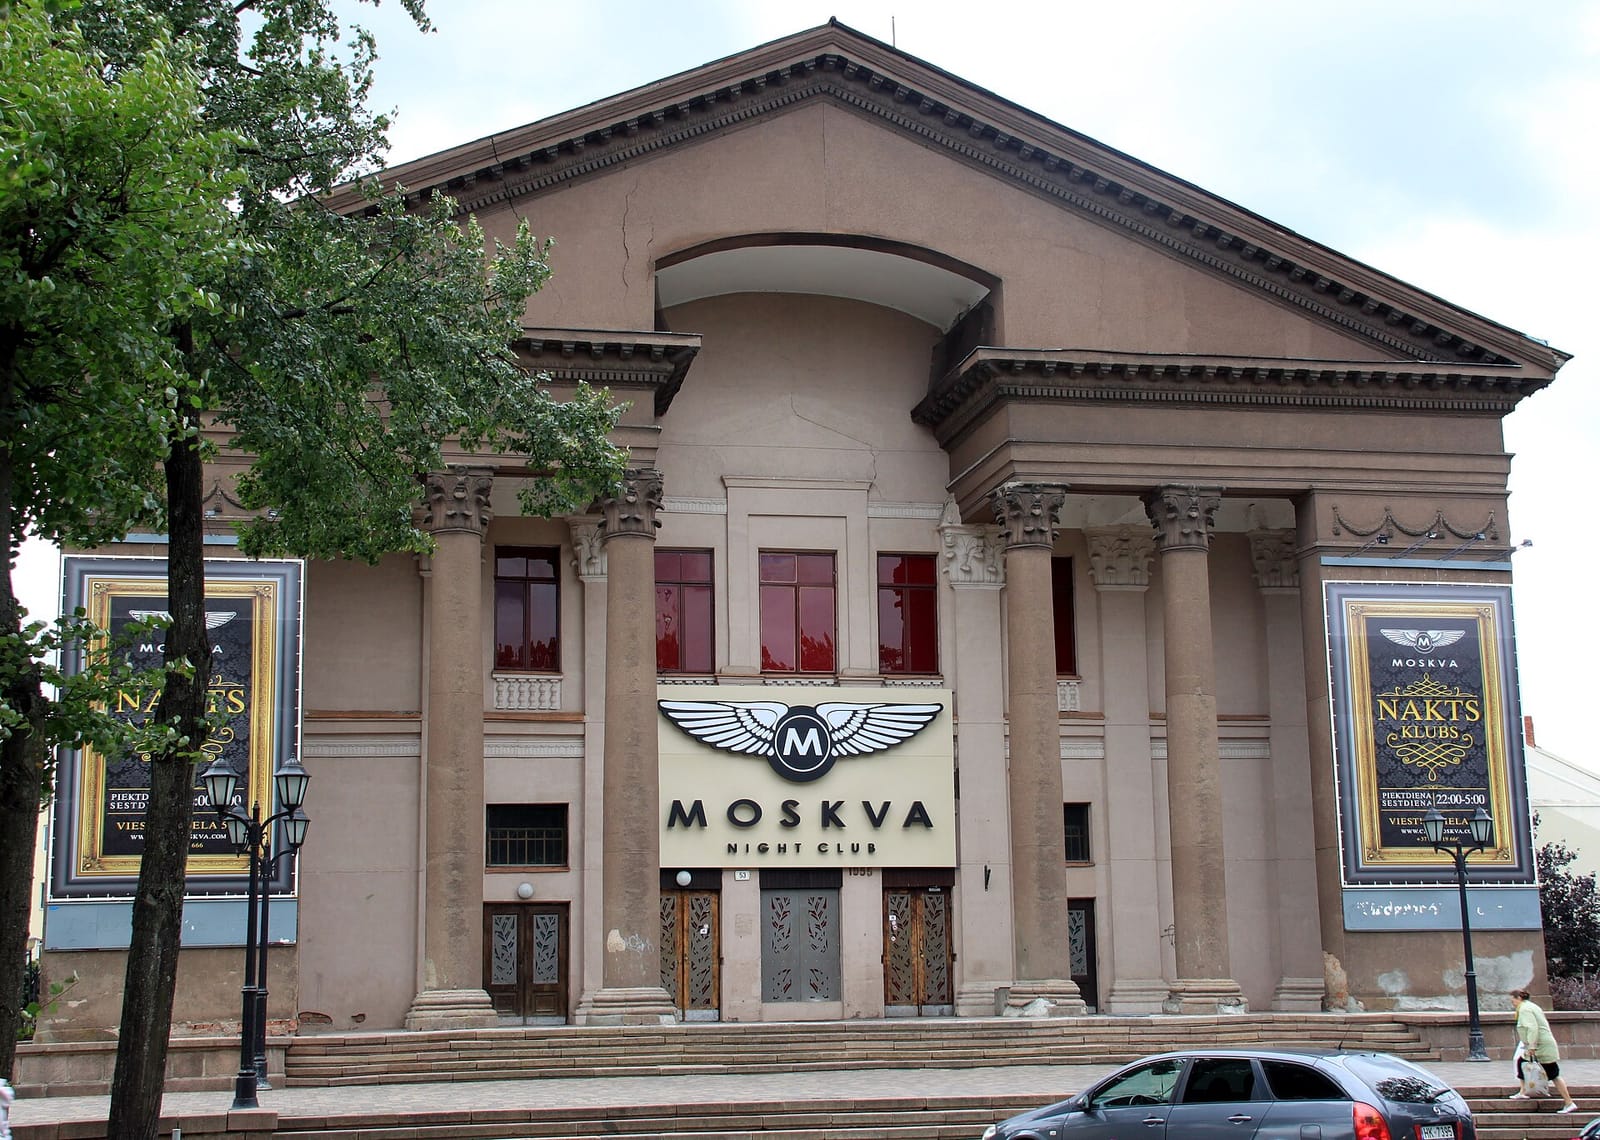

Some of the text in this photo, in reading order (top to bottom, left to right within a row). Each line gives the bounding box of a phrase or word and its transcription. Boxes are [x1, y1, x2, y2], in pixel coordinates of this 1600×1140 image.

[140, 643, 223, 653] MOA
[1392, 659, 1458, 667] MOSKVA
[115, 689, 246, 713] NATS
[1377, 699, 1480, 721] NAKTS
[1401, 725, 1458, 738] KLUBS
[783, 728, 823, 756] M
[111, 793, 150, 801] PIEKTD
[1436, 794, 1485, 805] 22:00-5:00
[110, 802, 149, 810] SESTD
[667, 798, 934, 828] MOSKVA
[728, 842, 877, 854] NIGHT CLUB
[739, 871, 747, 879] 53
